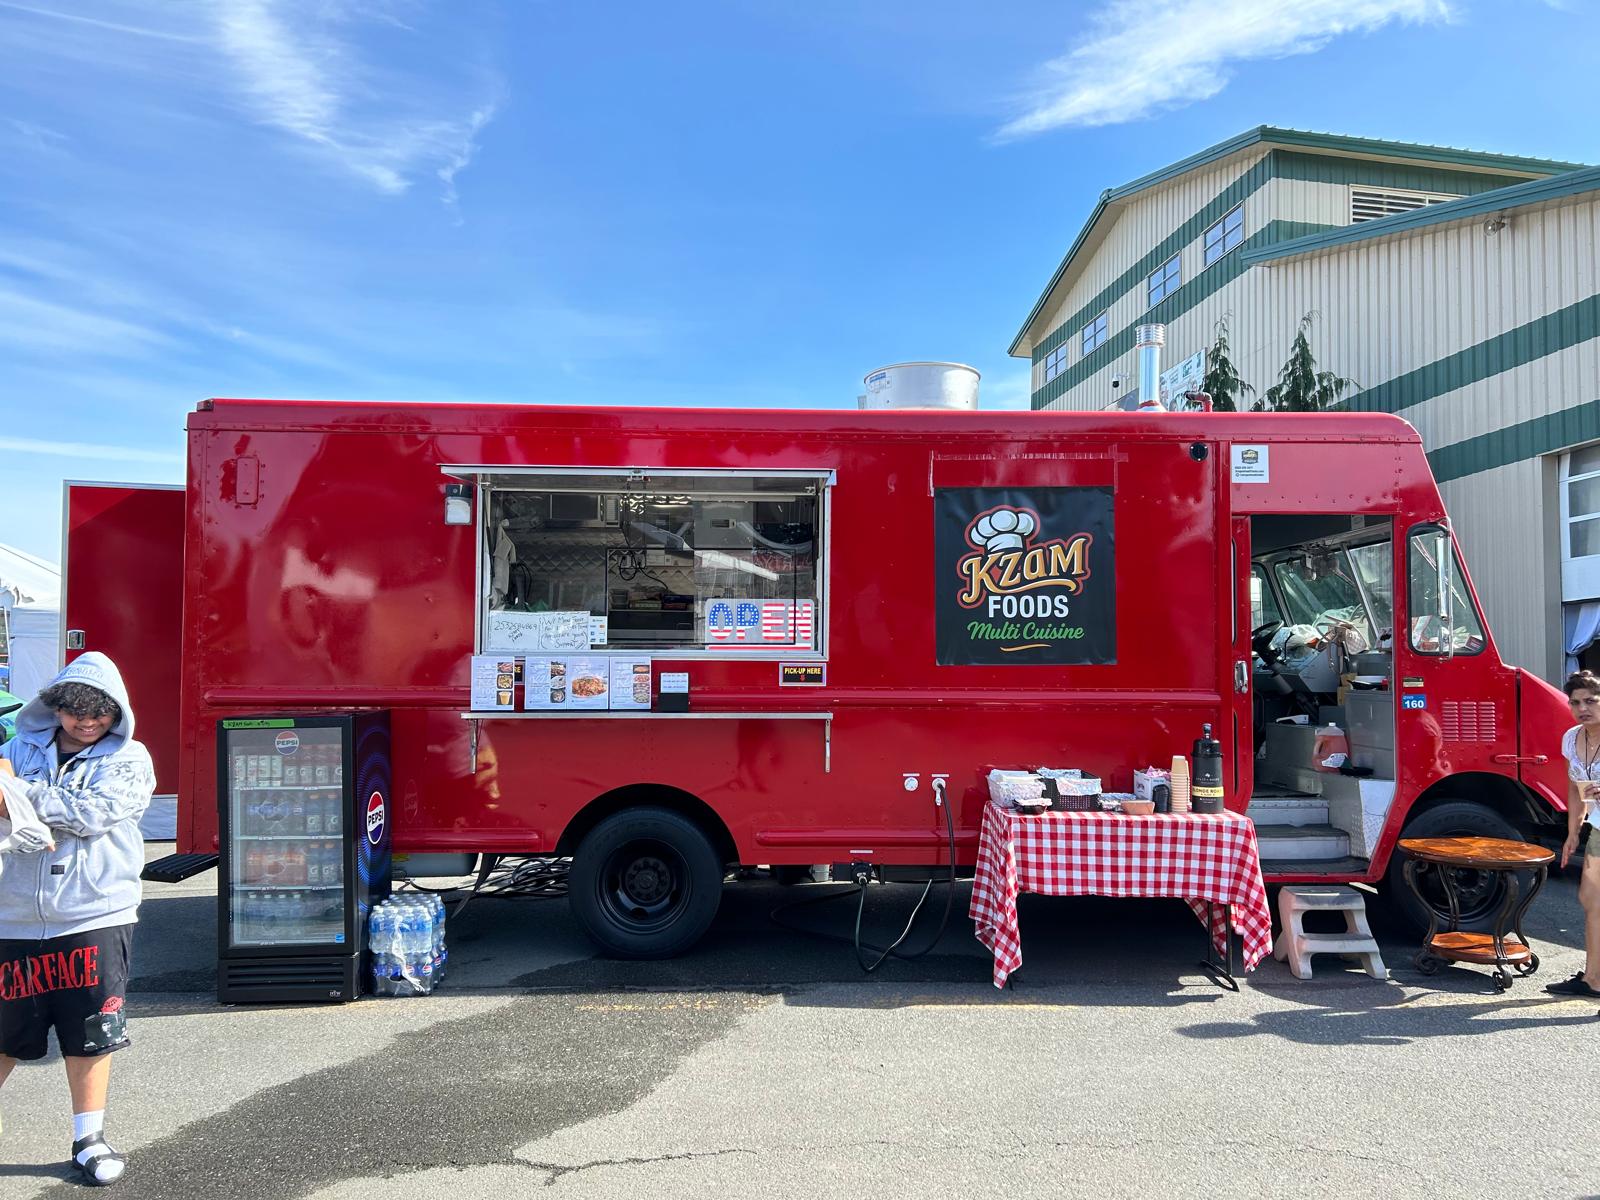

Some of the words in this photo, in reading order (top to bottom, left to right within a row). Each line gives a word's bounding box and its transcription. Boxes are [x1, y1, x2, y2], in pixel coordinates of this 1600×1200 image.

[988, 594, 1069, 618] FOODS
[708, 602, 811, 641] OPEN
[967, 621, 1021, 640] Multi
[1023, 621, 1085, 640] Cuisine
[1405, 699, 1424, 709] 160
[368, 809, 384, 826] PEPSI
[0, 945, 99, 1001] CARFACE
